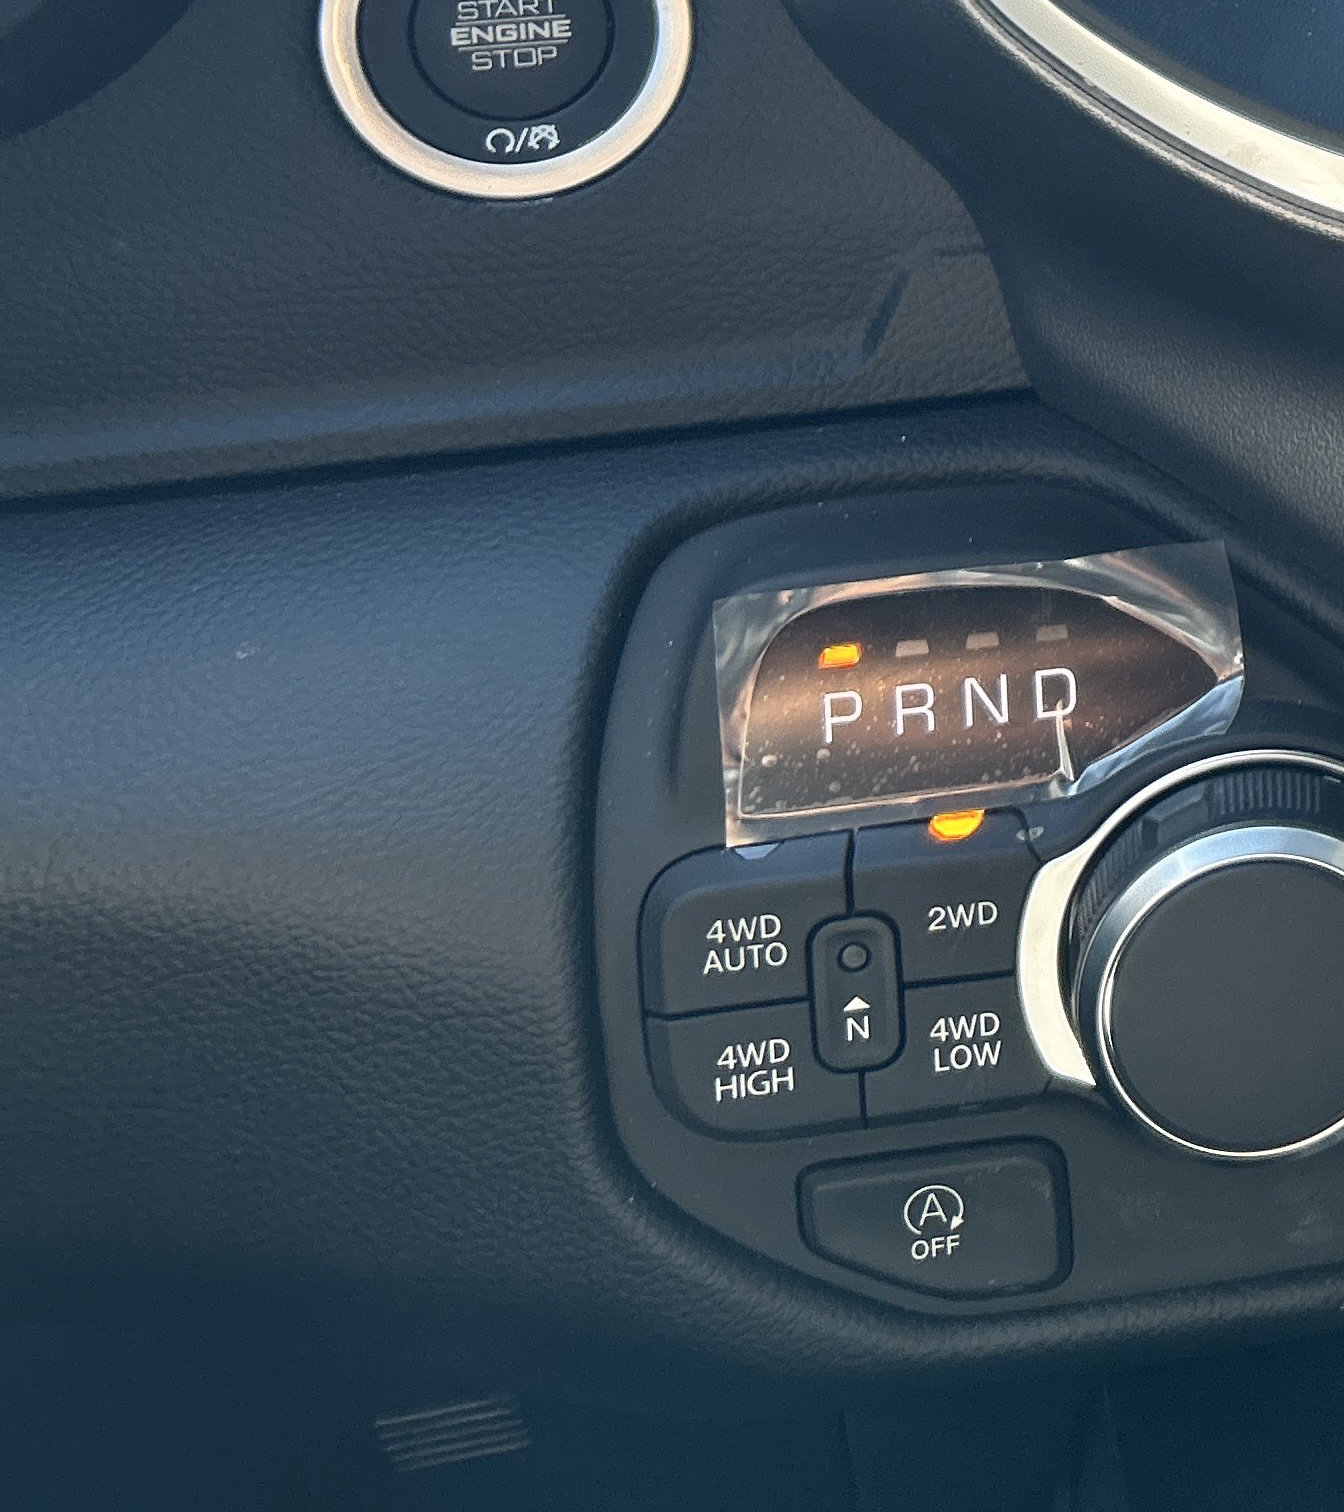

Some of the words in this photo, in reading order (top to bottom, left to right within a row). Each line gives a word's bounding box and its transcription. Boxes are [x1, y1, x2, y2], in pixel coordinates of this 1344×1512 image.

[450, 20, 573, 47] ENGINE
[471, 47, 559, 72] STOP
[705, 913, 782, 944] 4WD
[927, 900, 999, 932] 2WD
[703, 943, 789, 976] AUTO
[845, 1016, 871, 1043] N
[929, 1012, 1001, 1043] 4WD
[717, 1038, 791, 1070] 4WD
[933, 1040, 1002, 1073] LOW
[714, 1066, 796, 1102] HIGH
[910, 1235, 961, 1262] OFF
